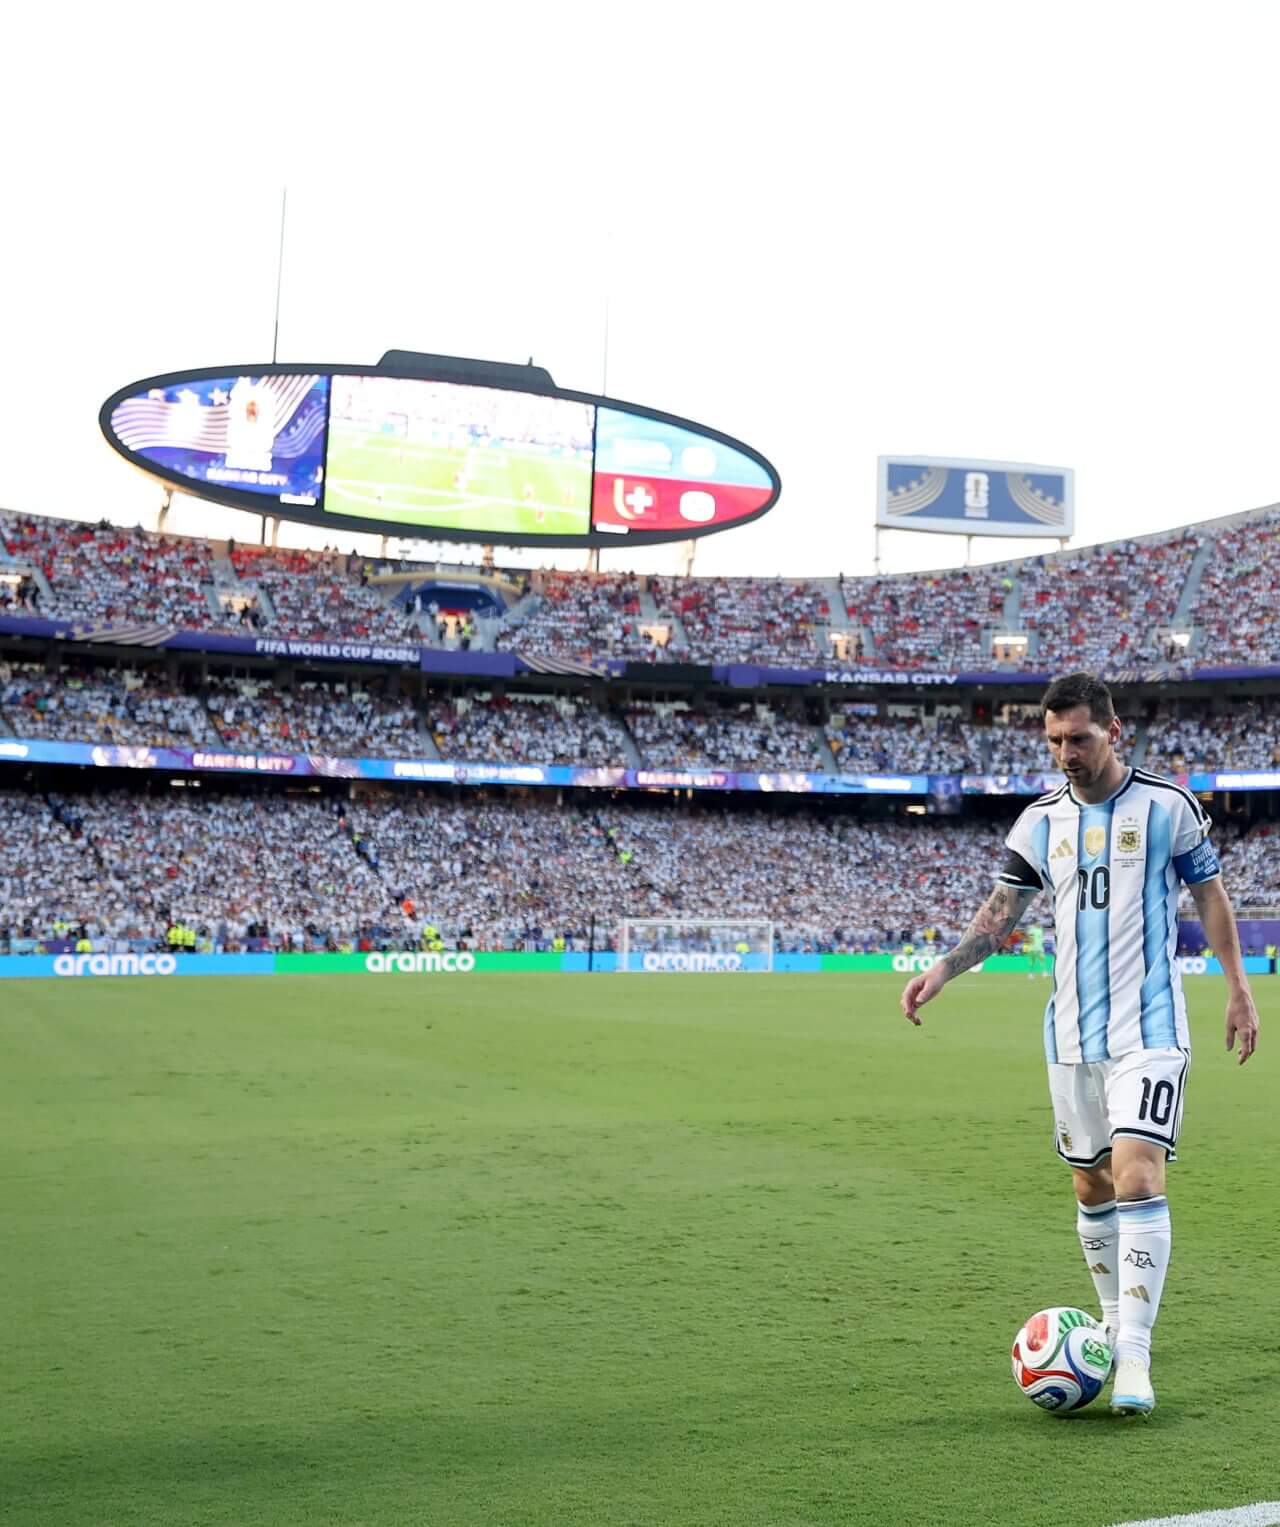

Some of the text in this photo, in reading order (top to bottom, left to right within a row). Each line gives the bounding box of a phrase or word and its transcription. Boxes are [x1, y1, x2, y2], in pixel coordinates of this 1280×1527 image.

[255, 638, 288, 654] FIFA
[288, 641, 341, 657] WORLD
[342, 644, 370, 659] CUP
[825, 671, 908, 684] KANSAS
[1078, 865, 1110, 911] 10
[54, 954, 176, 976] aramco
[365, 951, 475, 973] aramco
[643, 951, 741, 972] aramco
[1138, 1076, 1174, 1126] 10
[1124, 1247, 1156, 1269] AFA
